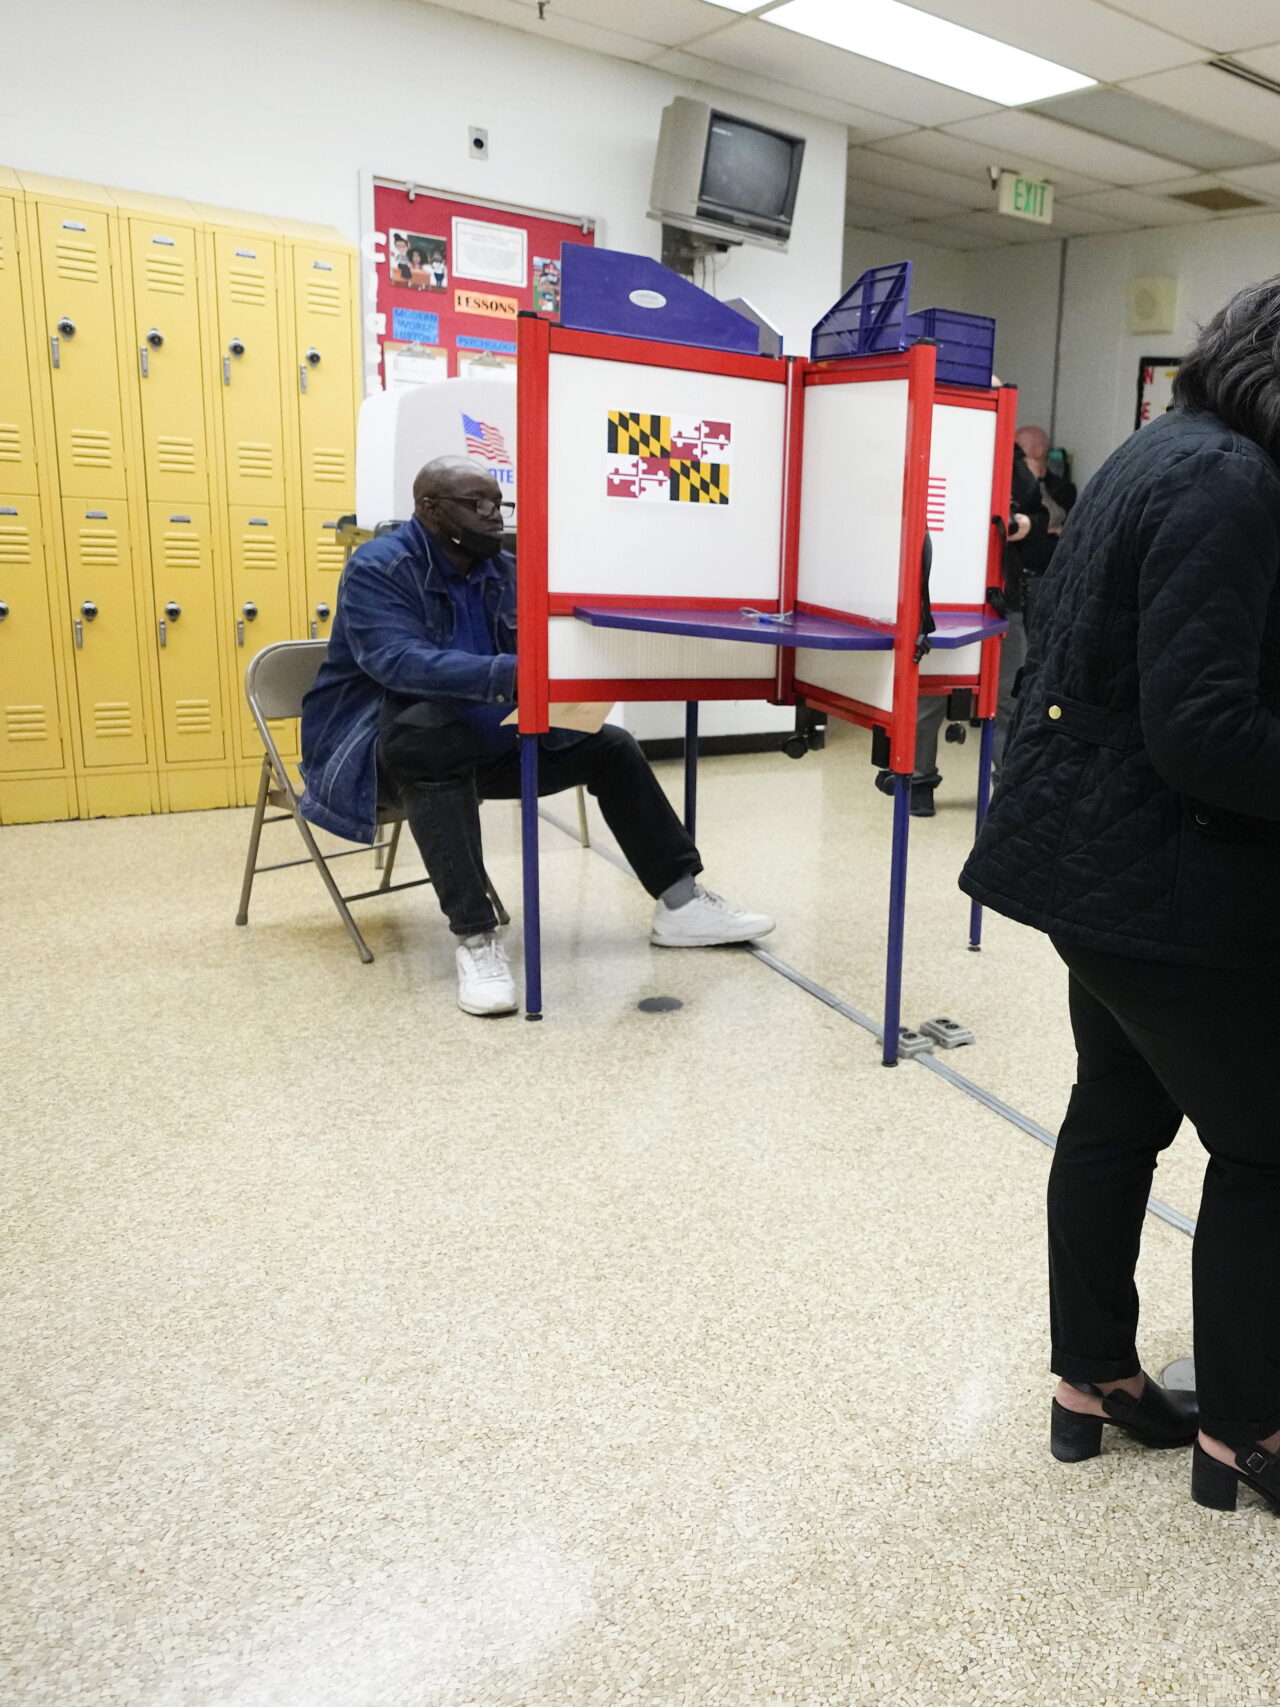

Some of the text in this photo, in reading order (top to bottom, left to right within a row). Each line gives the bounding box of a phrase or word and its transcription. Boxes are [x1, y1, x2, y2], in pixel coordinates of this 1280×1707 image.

[1014, 178, 1046, 216] EXIT
[457, 295, 515, 314] LESSONS
[488, 468, 514, 484] OTE
